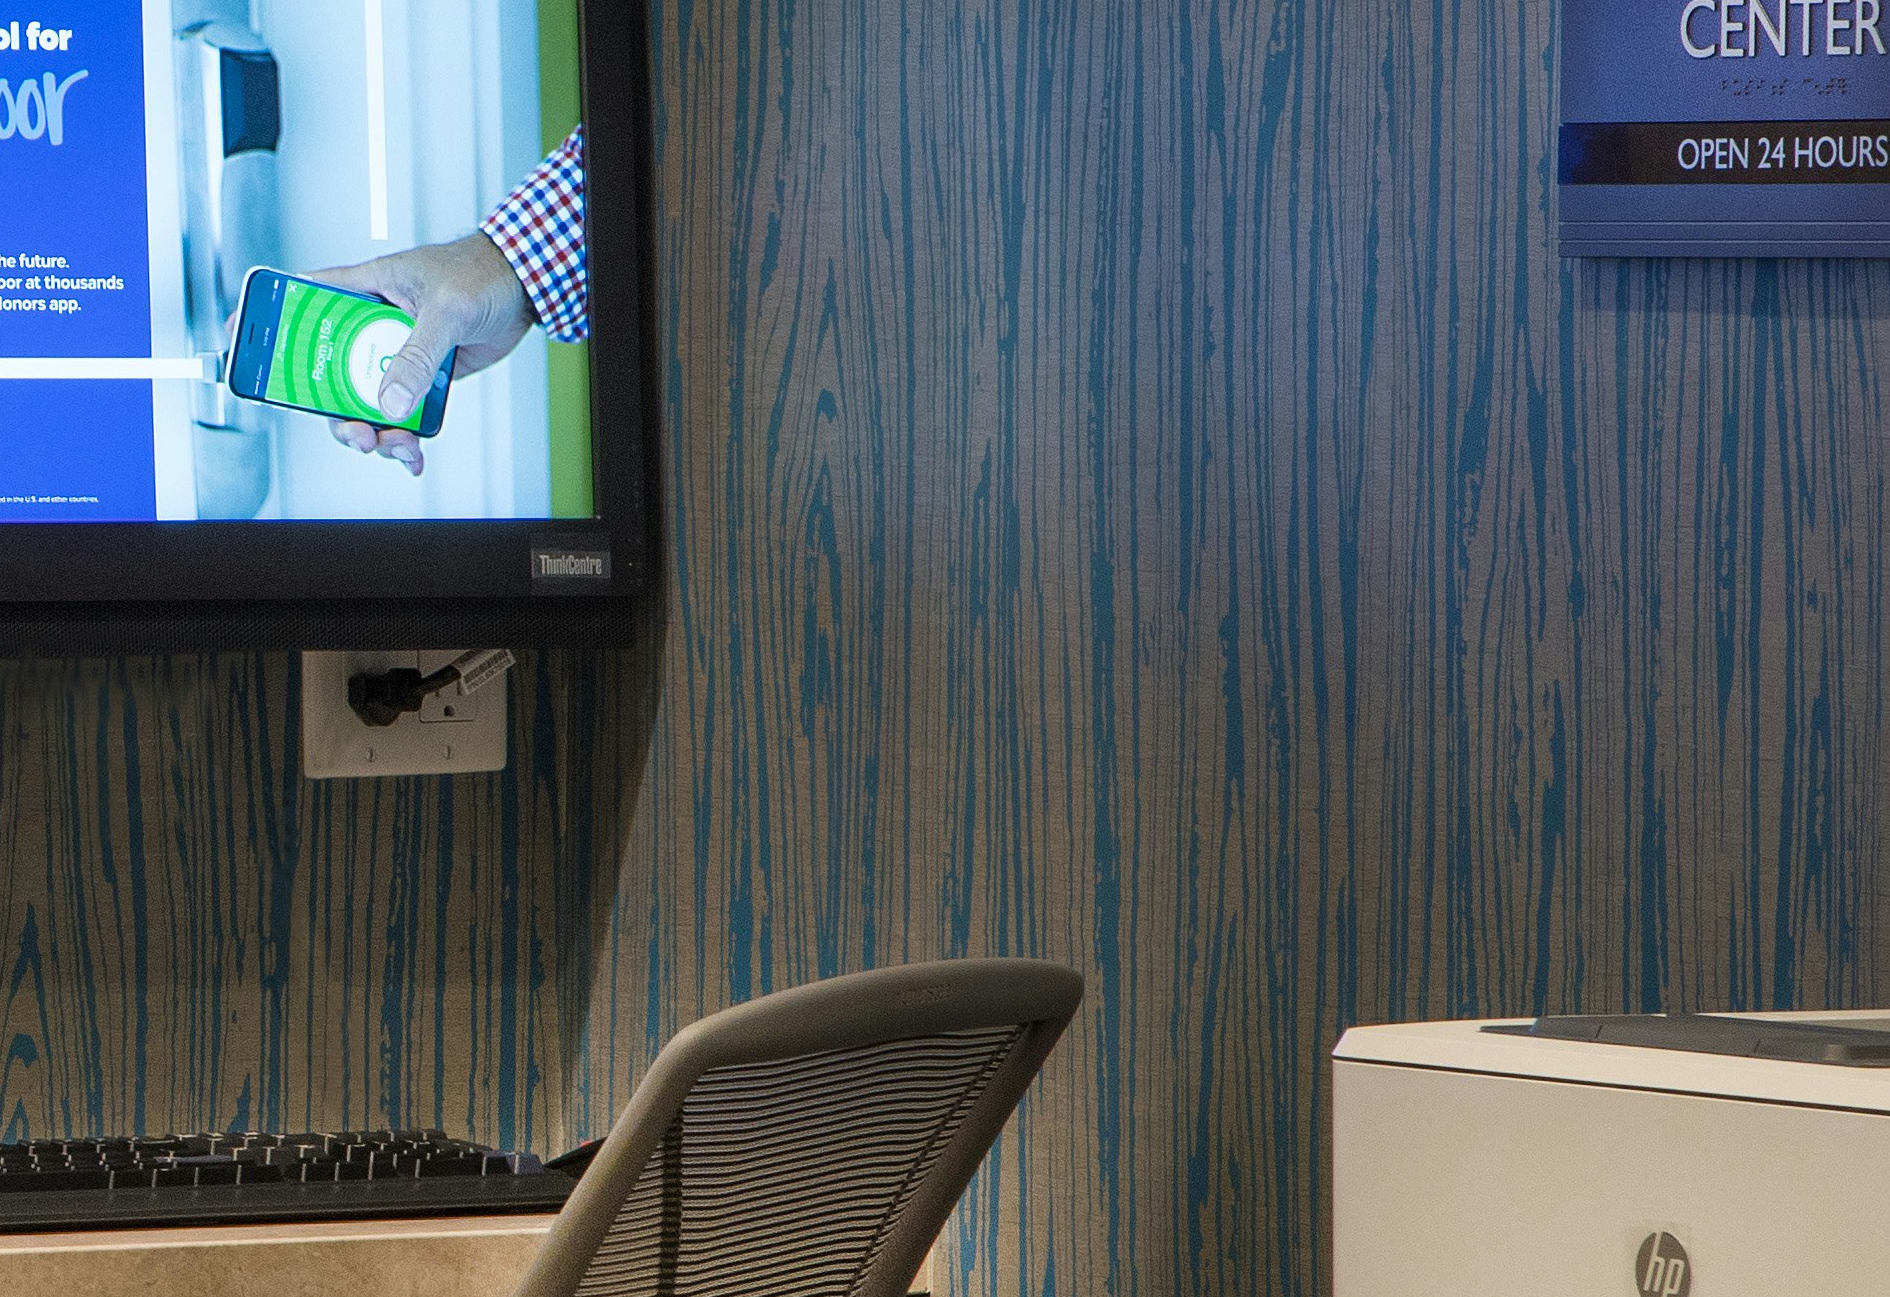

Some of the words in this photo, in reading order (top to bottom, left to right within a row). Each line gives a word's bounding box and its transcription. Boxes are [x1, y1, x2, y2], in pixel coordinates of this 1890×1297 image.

[27, 22, 72, 50] for
[1677, 139, 1750, 170] OPEN
[1757, 138, 1786, 170] 24
[1794, 136, 1888, 168] HOURS
[19, 254, 69, 268] future.
[25, 276, 41, 289] at
[44, 275, 124, 289] thousands
[49, 300, 81, 313] app.
[319, 318, 333, 342] 152
[312, 344, 328, 381] Room
[539, 555, 602, 575] ThinkCentre
